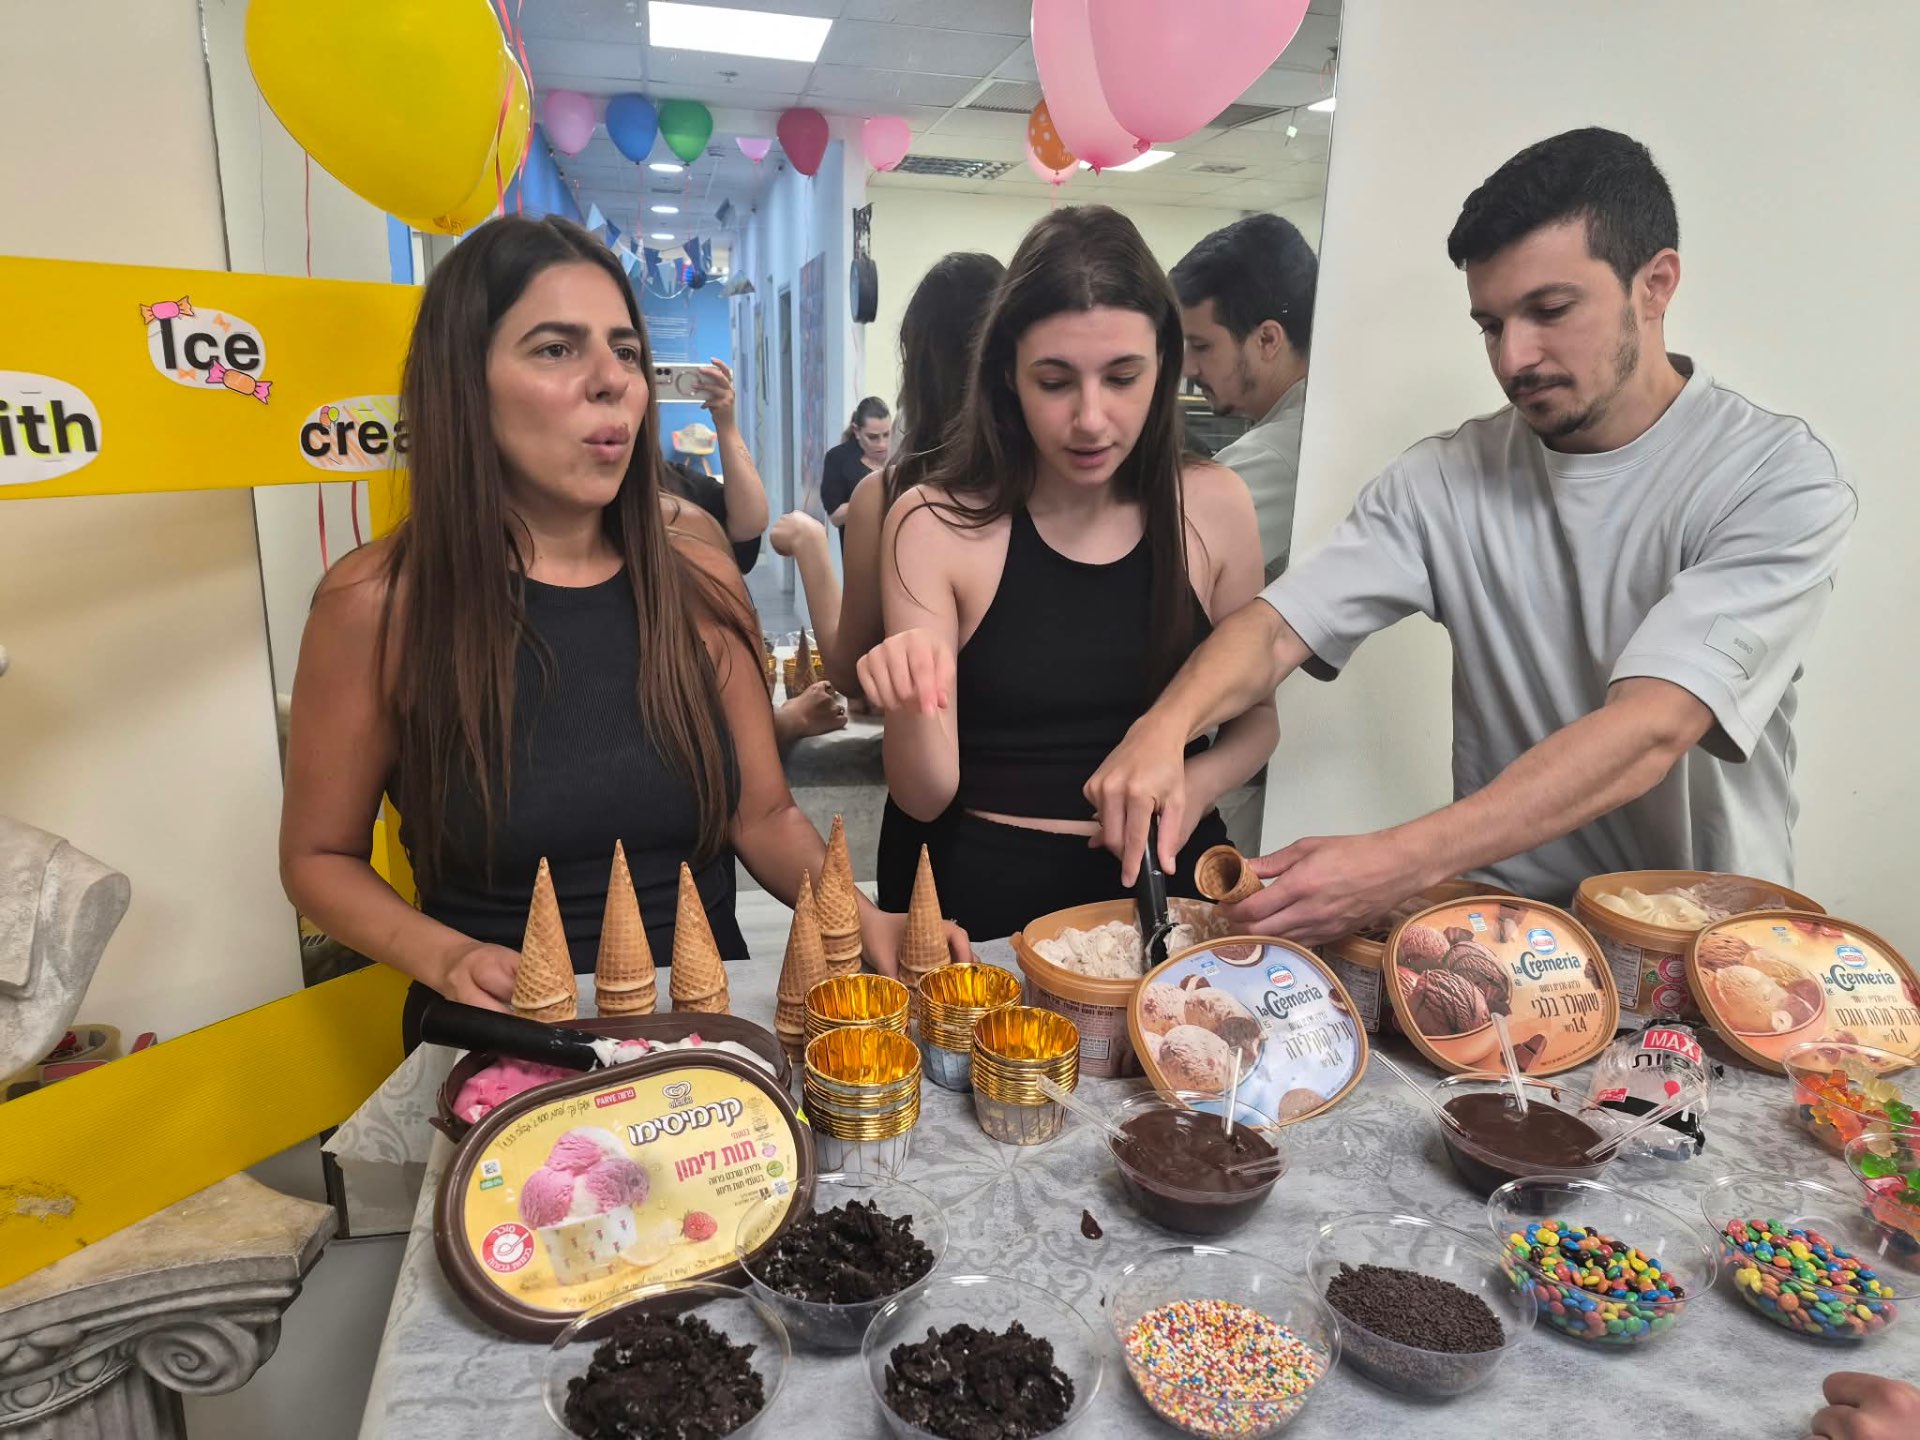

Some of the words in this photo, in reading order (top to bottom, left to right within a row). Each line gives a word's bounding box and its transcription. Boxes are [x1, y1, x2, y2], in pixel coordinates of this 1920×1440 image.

[159, 318, 260, 371] Ice
[0, 400, 98, 457] ith
[300, 420, 412, 458] crea
[1511, 962, 1522, 975] la
[1520, 951, 1582, 981] Cremeria
[1820, 973, 1834, 985] la
[1829, 964, 1896, 992] Cremeria
[1256, 1005, 1268, 1017] la
[1263, 983, 1324, 1020] Cremeria
[1530, 996, 1561, 1018] בלגי
[1559, 992, 1600, 1016] שוקולד
[1650, 1031, 1695, 1057] MAX
[627, 1097, 743, 1146] קרמיסימו
[674, 1150, 717, 1182] לימון
[721, 1140, 757, 1166] תות
[492, 1225, 516, 1236] סוכר
